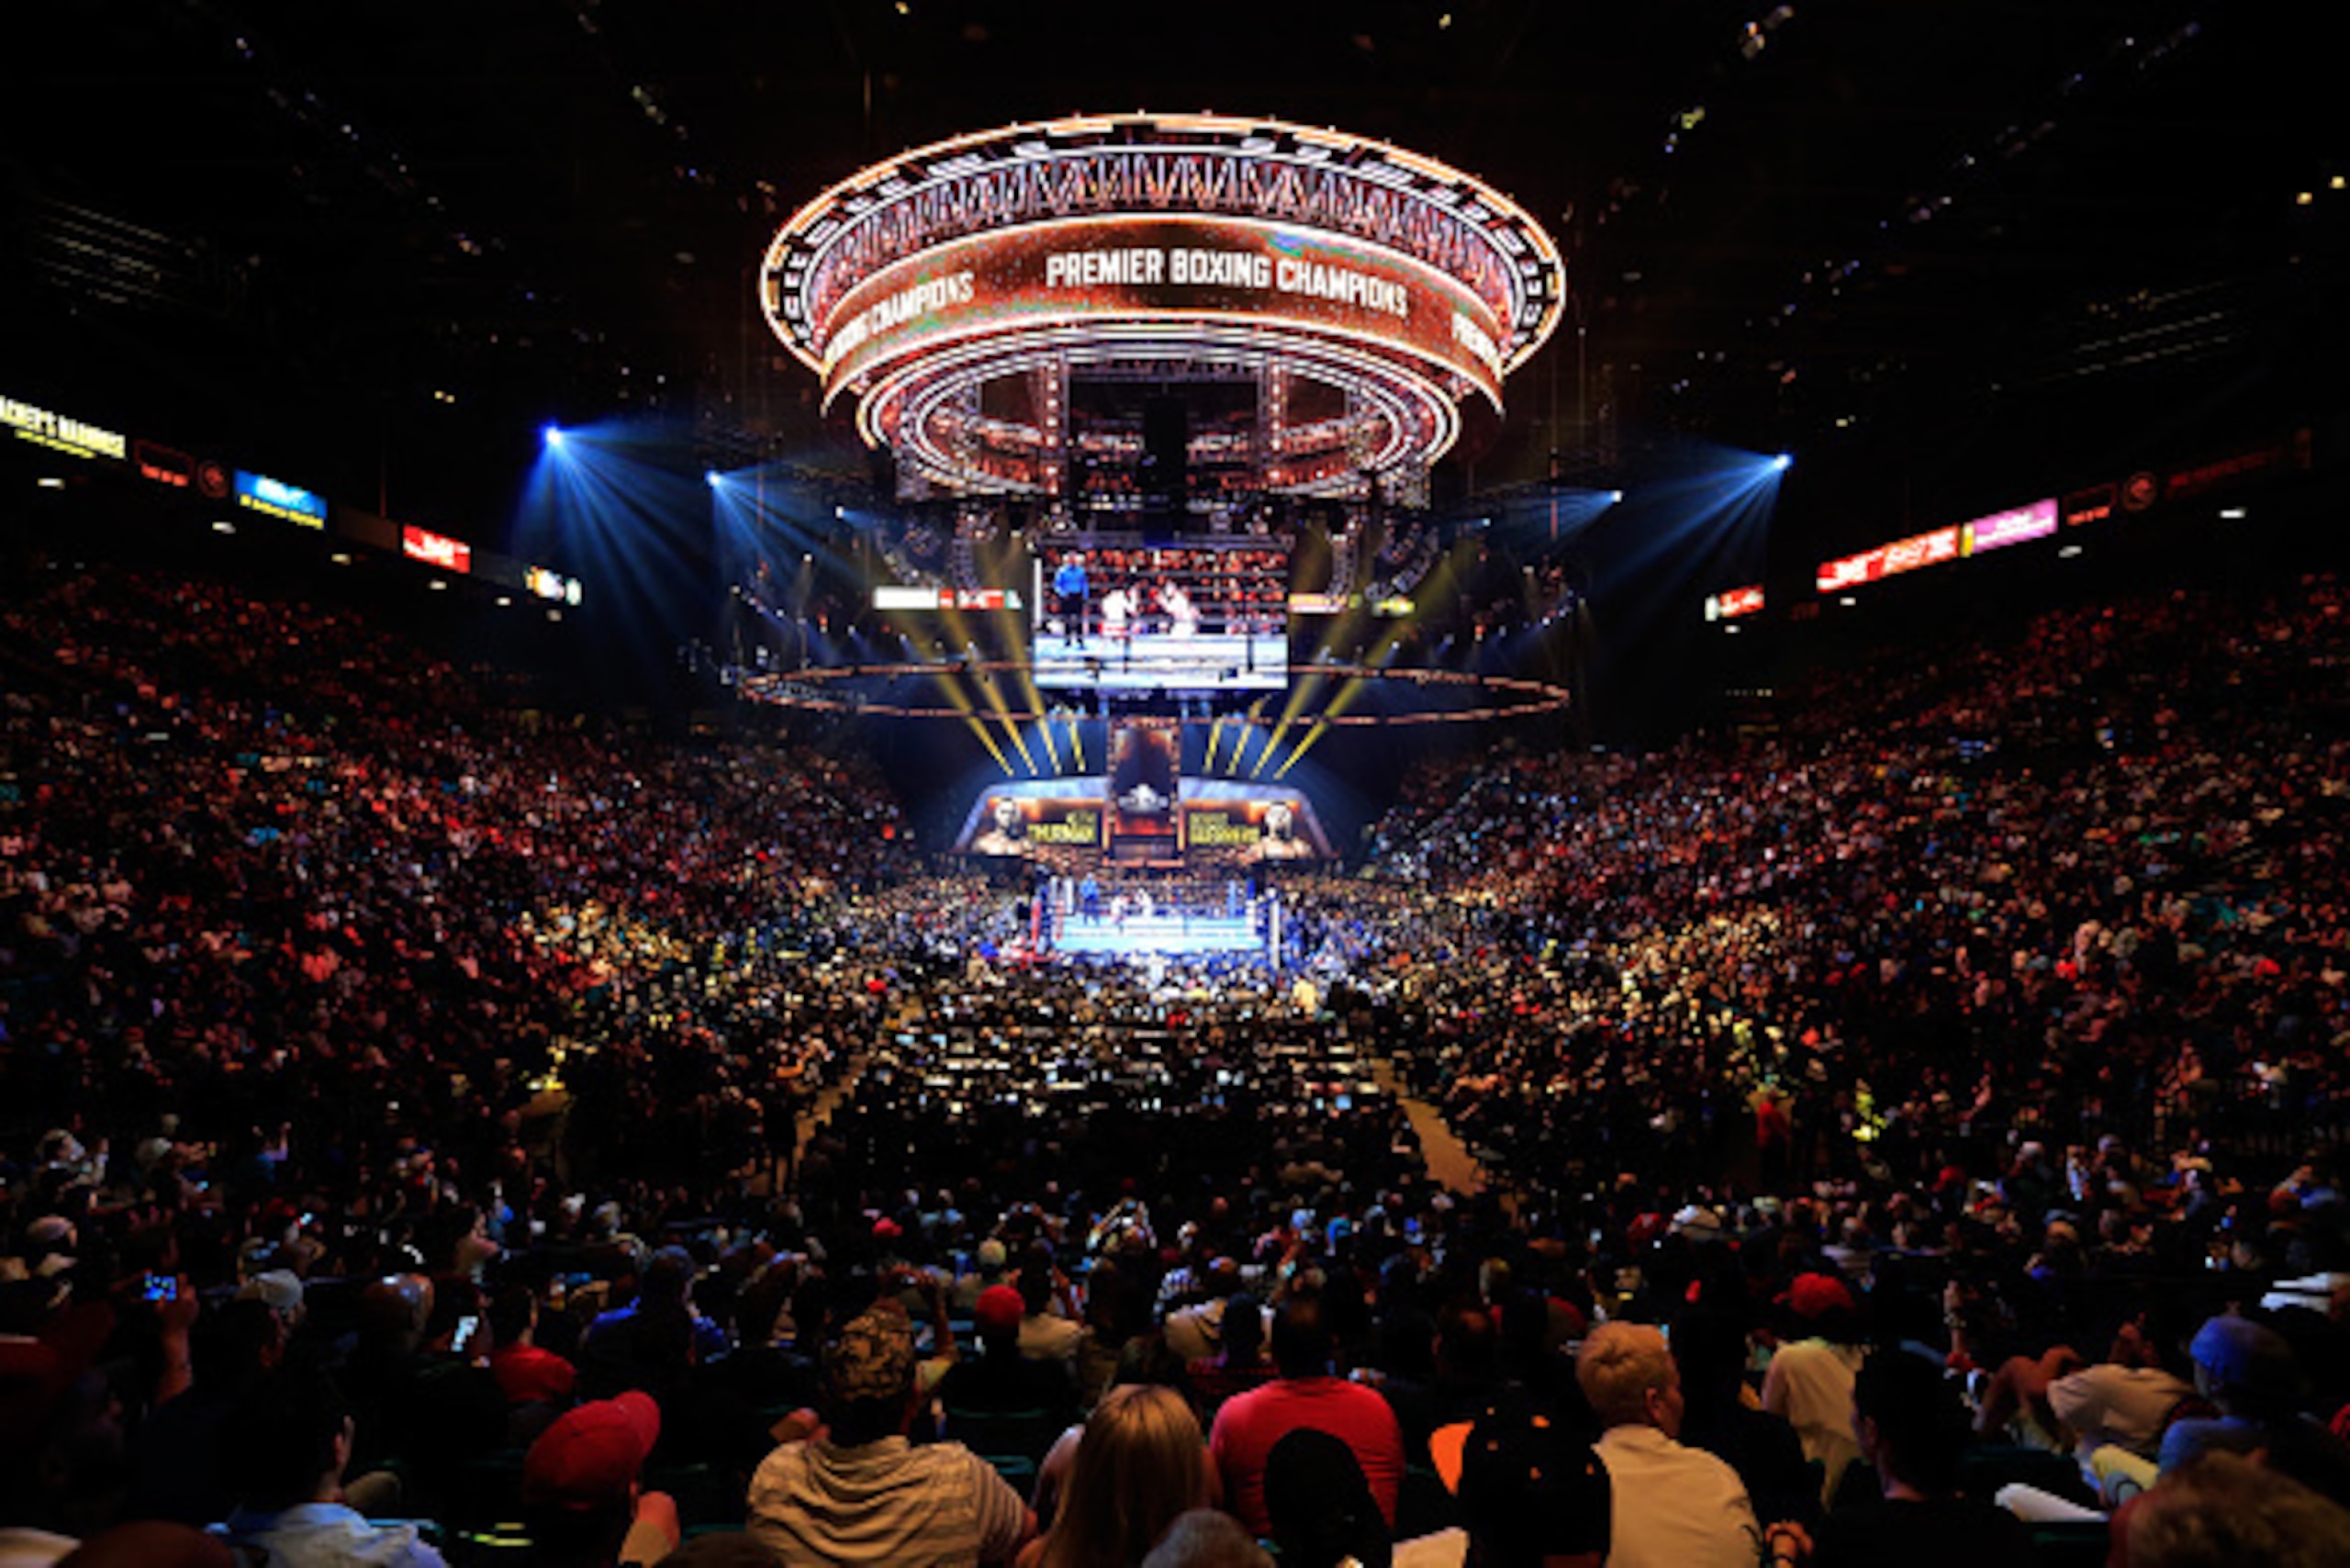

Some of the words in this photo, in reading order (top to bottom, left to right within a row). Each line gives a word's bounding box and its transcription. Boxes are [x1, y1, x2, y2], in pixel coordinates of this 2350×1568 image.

[869, 271, 975, 336] CHAMPIONS
[1046, 247, 1165, 288] PREMIER
[1169, 247, 1271, 289] BOXING
[1276, 257, 1408, 319] CHAMPIONS
